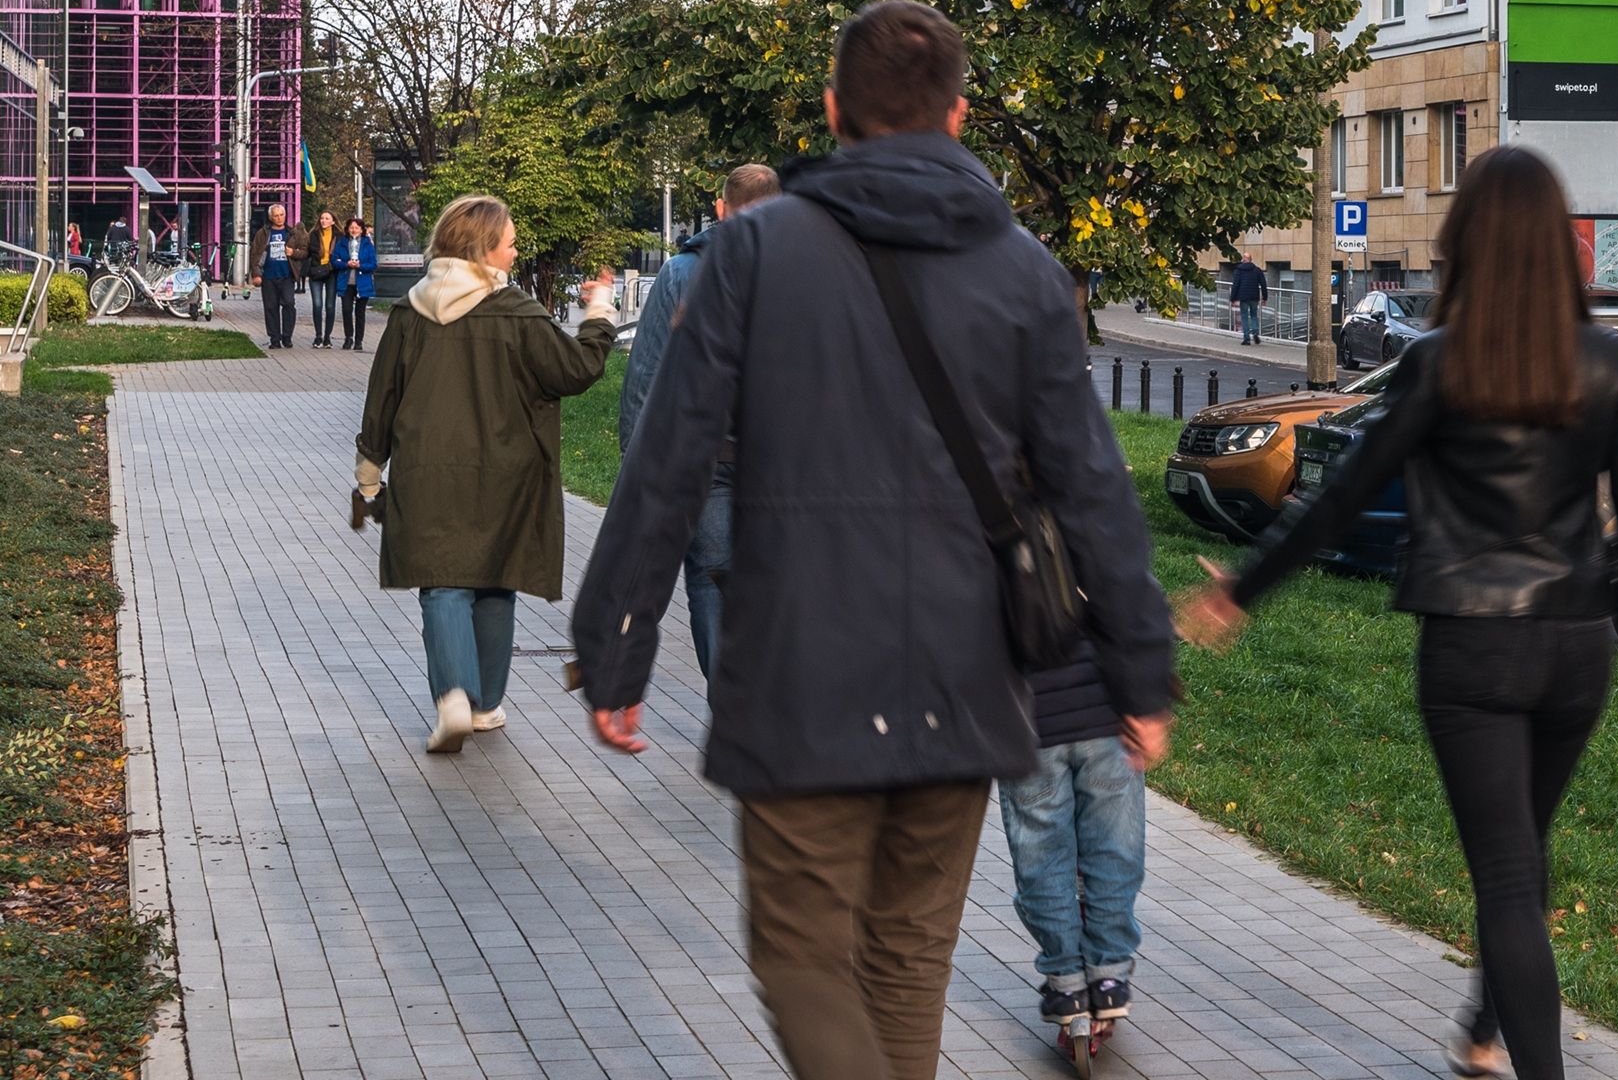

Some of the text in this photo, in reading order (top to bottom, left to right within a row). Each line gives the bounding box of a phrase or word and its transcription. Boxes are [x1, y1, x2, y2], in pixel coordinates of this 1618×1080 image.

[1554, 83, 1598, 94] swipeto.pl
[1343, 205, 1361, 232] P
[1337, 240, 1366, 248] Koniec
